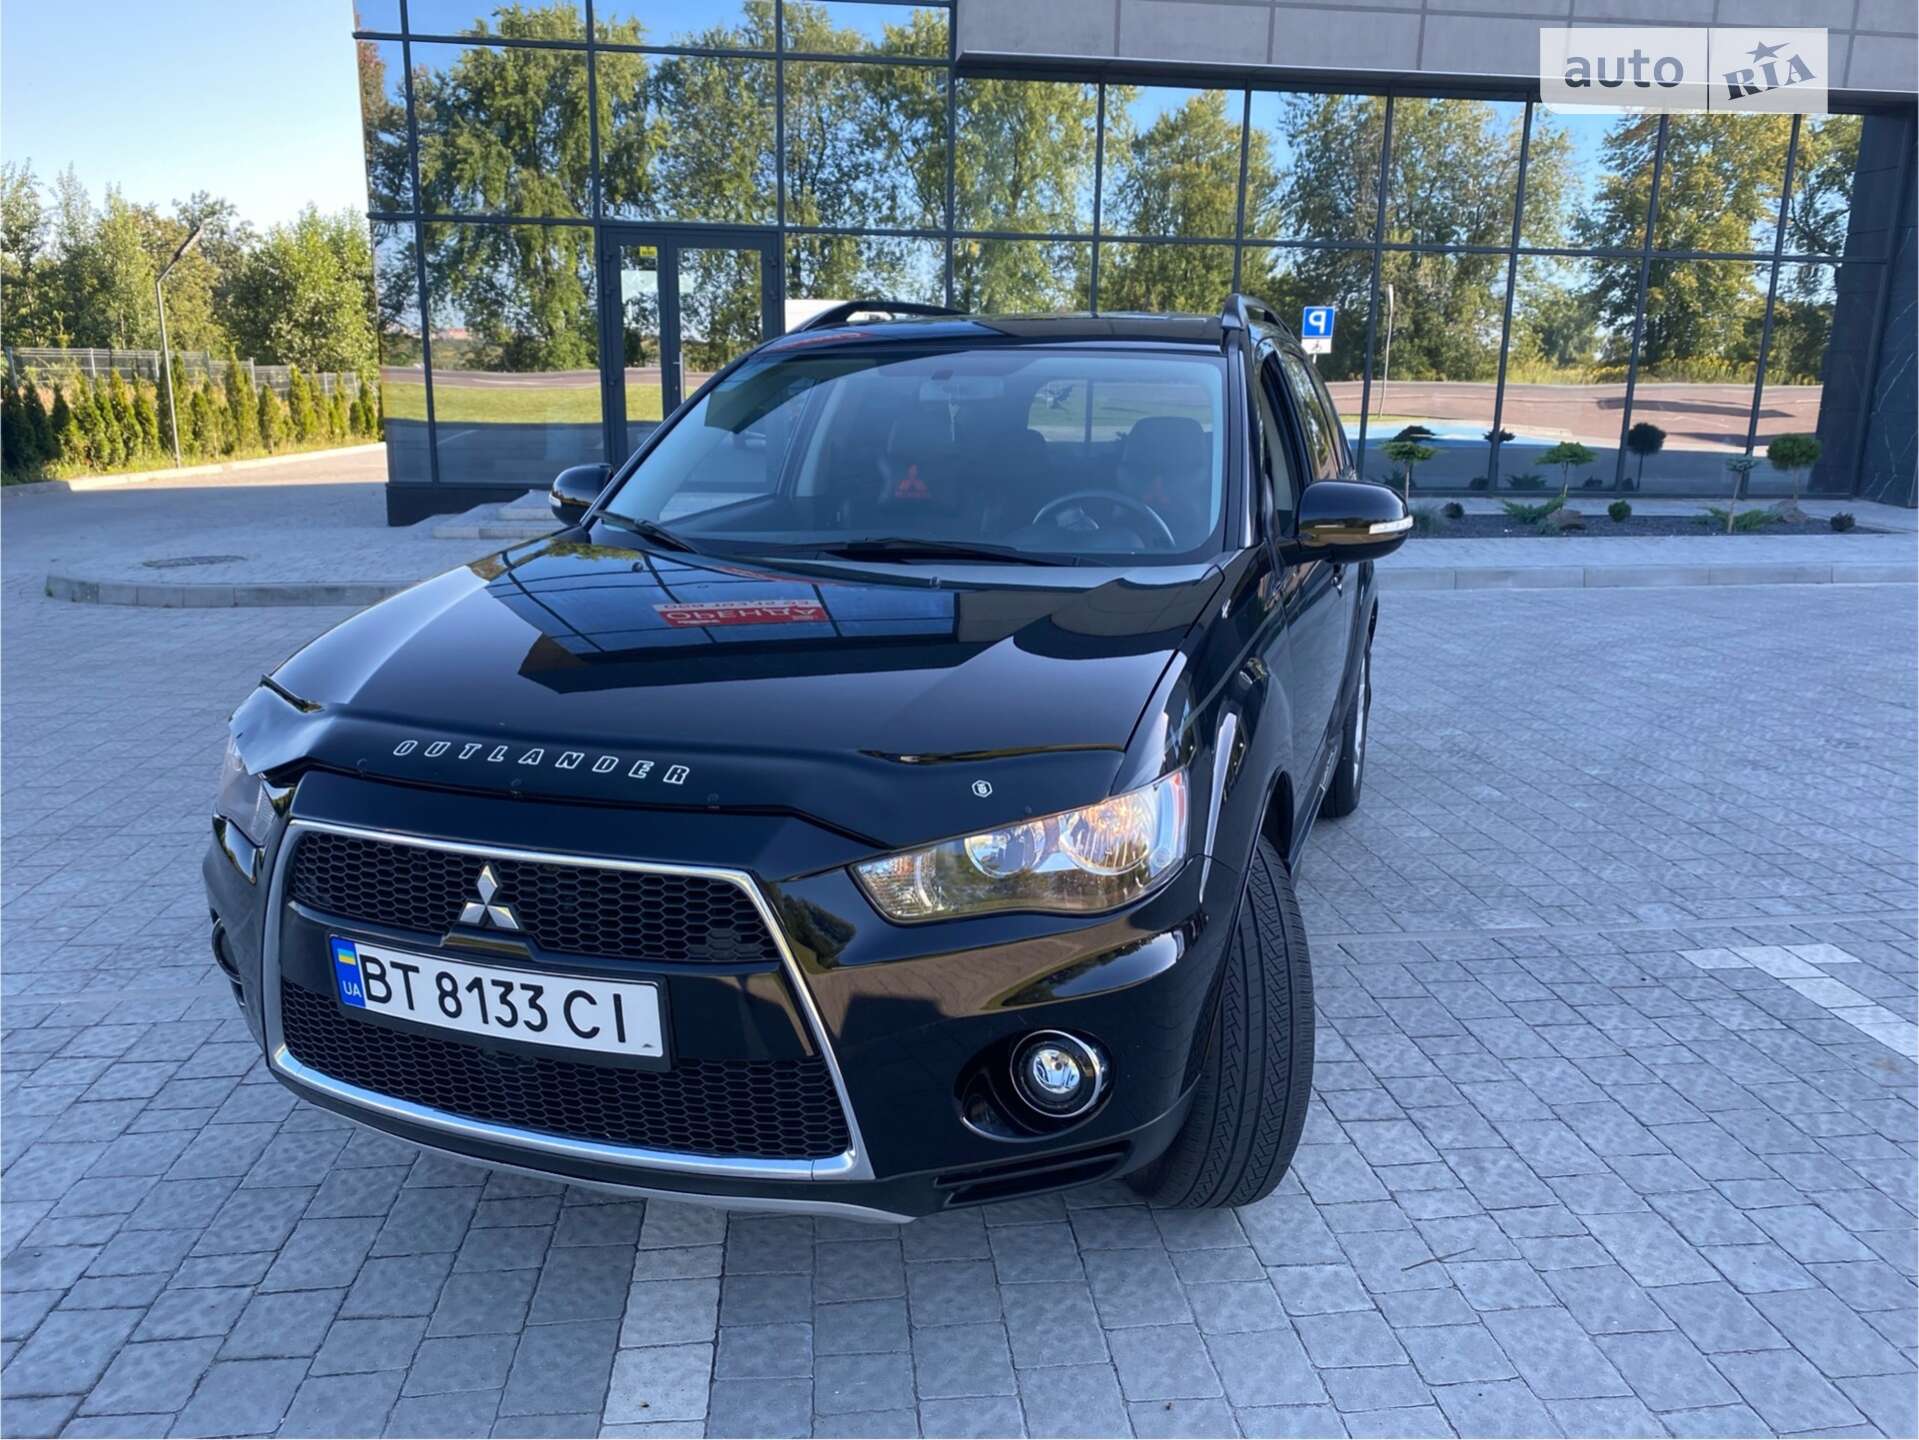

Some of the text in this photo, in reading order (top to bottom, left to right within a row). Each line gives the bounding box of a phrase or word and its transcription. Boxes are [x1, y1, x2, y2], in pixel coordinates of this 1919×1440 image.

[392, 739, 690, 785] OUTLANDER
[342, 980, 362, 999] UA
[359, 953, 626, 1043] BT 8133 CI
